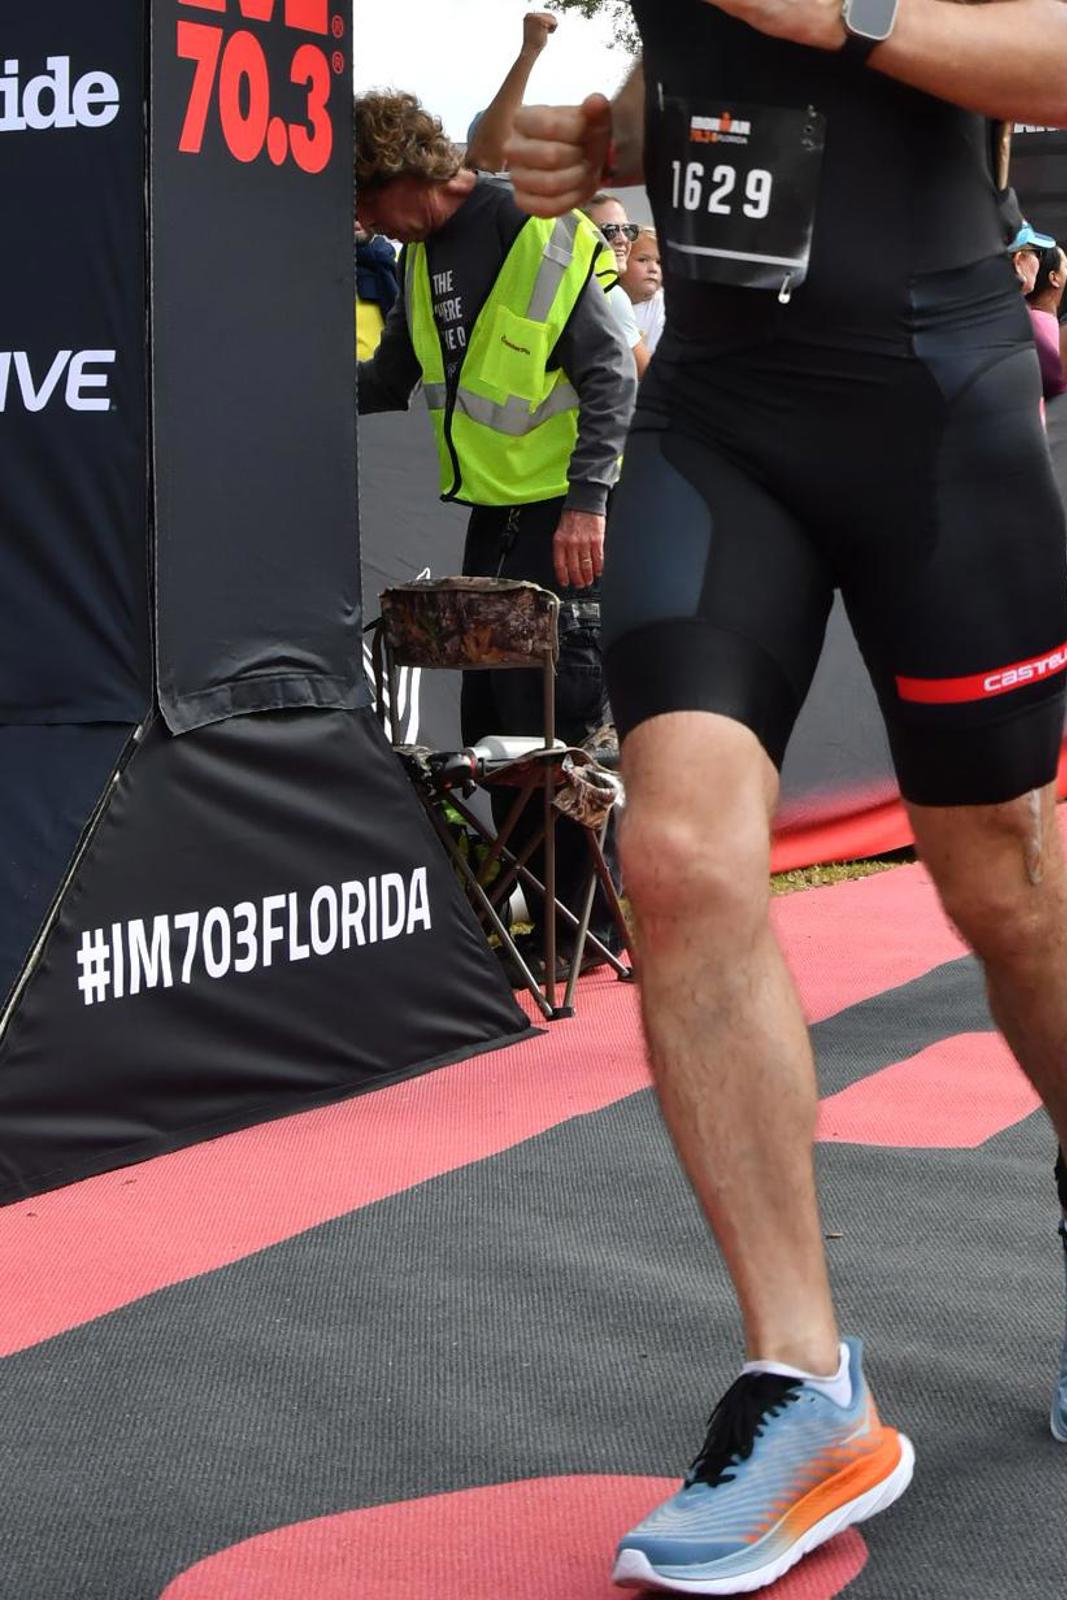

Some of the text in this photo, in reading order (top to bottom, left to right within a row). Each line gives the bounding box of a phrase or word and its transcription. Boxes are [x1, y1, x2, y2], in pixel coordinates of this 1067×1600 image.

[177, 20, 332, 174] 70.3
[672, 160, 773, 220] 1629
[76, 866, 433, 1006] #IM703FLORIDA
